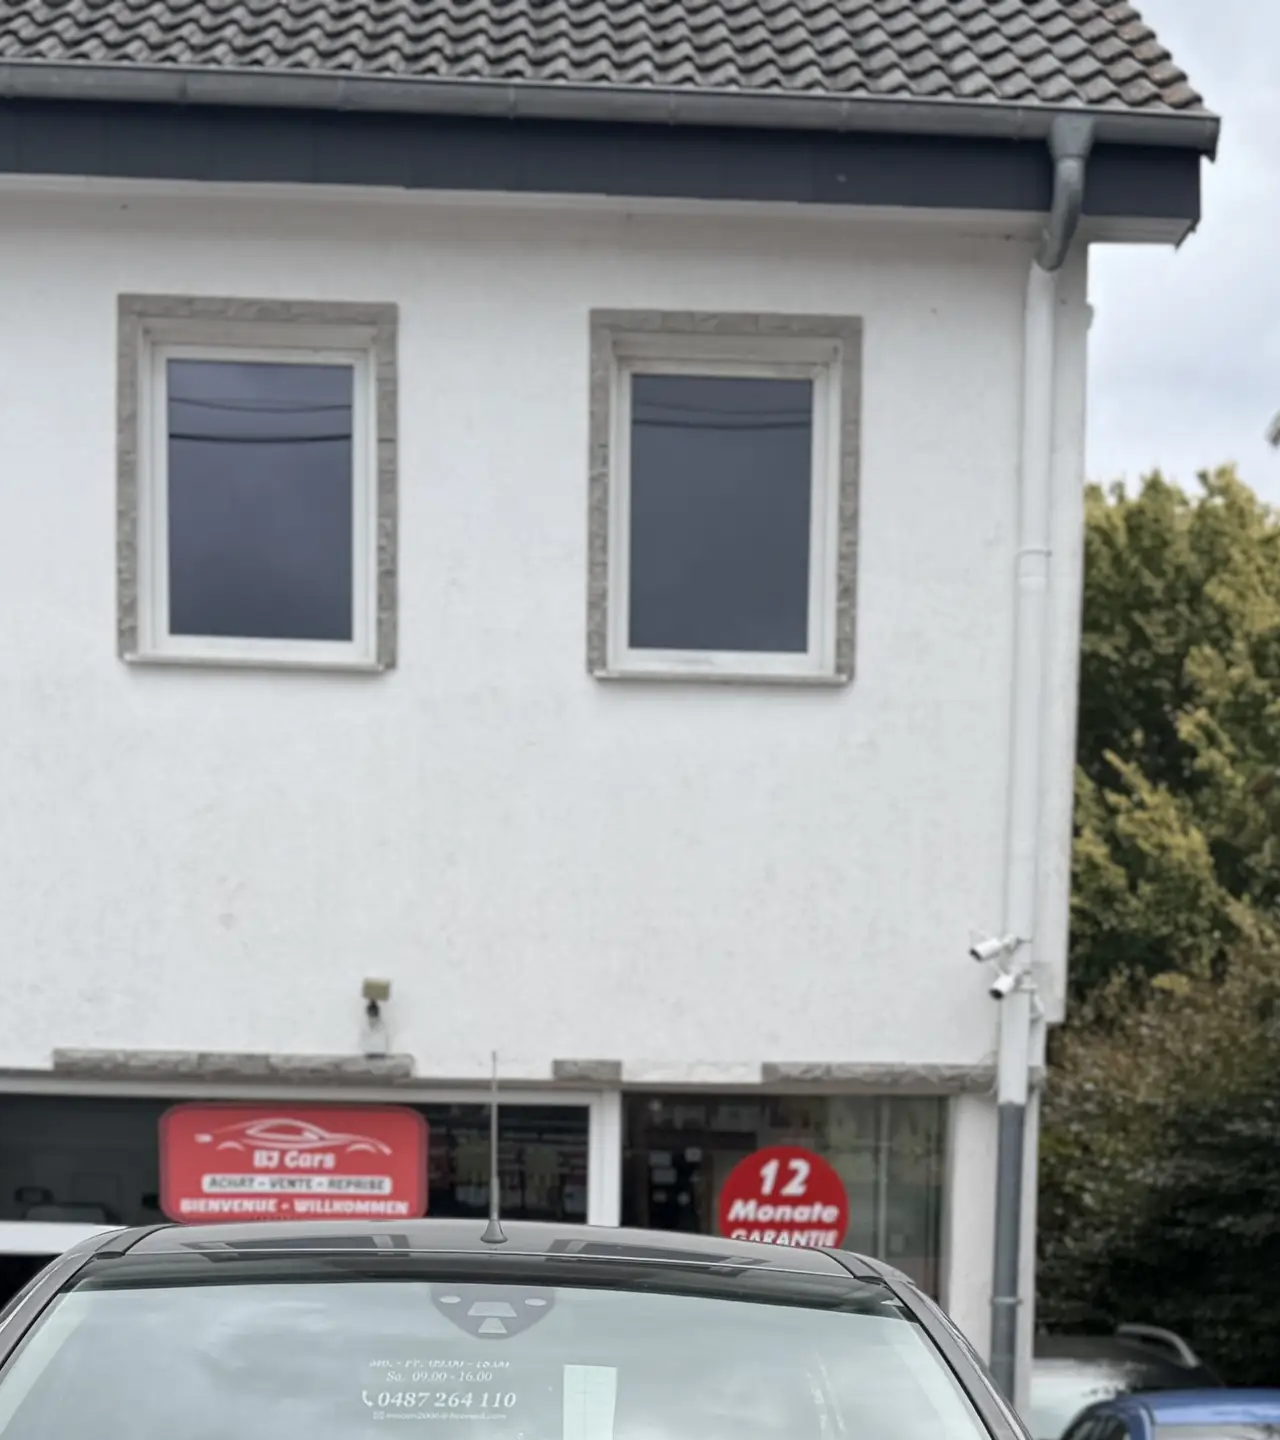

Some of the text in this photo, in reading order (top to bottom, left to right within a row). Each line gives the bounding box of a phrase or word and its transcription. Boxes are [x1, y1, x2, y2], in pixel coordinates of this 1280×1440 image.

[284, 1150, 335, 1169] Cars
[208, 1178, 255, 1190] ACHAT
[270, 1178, 313, 1190] VENTE
[328, 1179, 385, 1191] REPRISE
[760, 1158, 810, 1197] 12
[180, 1198, 277, 1213] BIENVENUE
[293, 1199, 410, 1215] WILLKOMMEN
[727, 1198, 840, 1224] Monate
[378, 1392, 517, 1407] 0487 264 110
